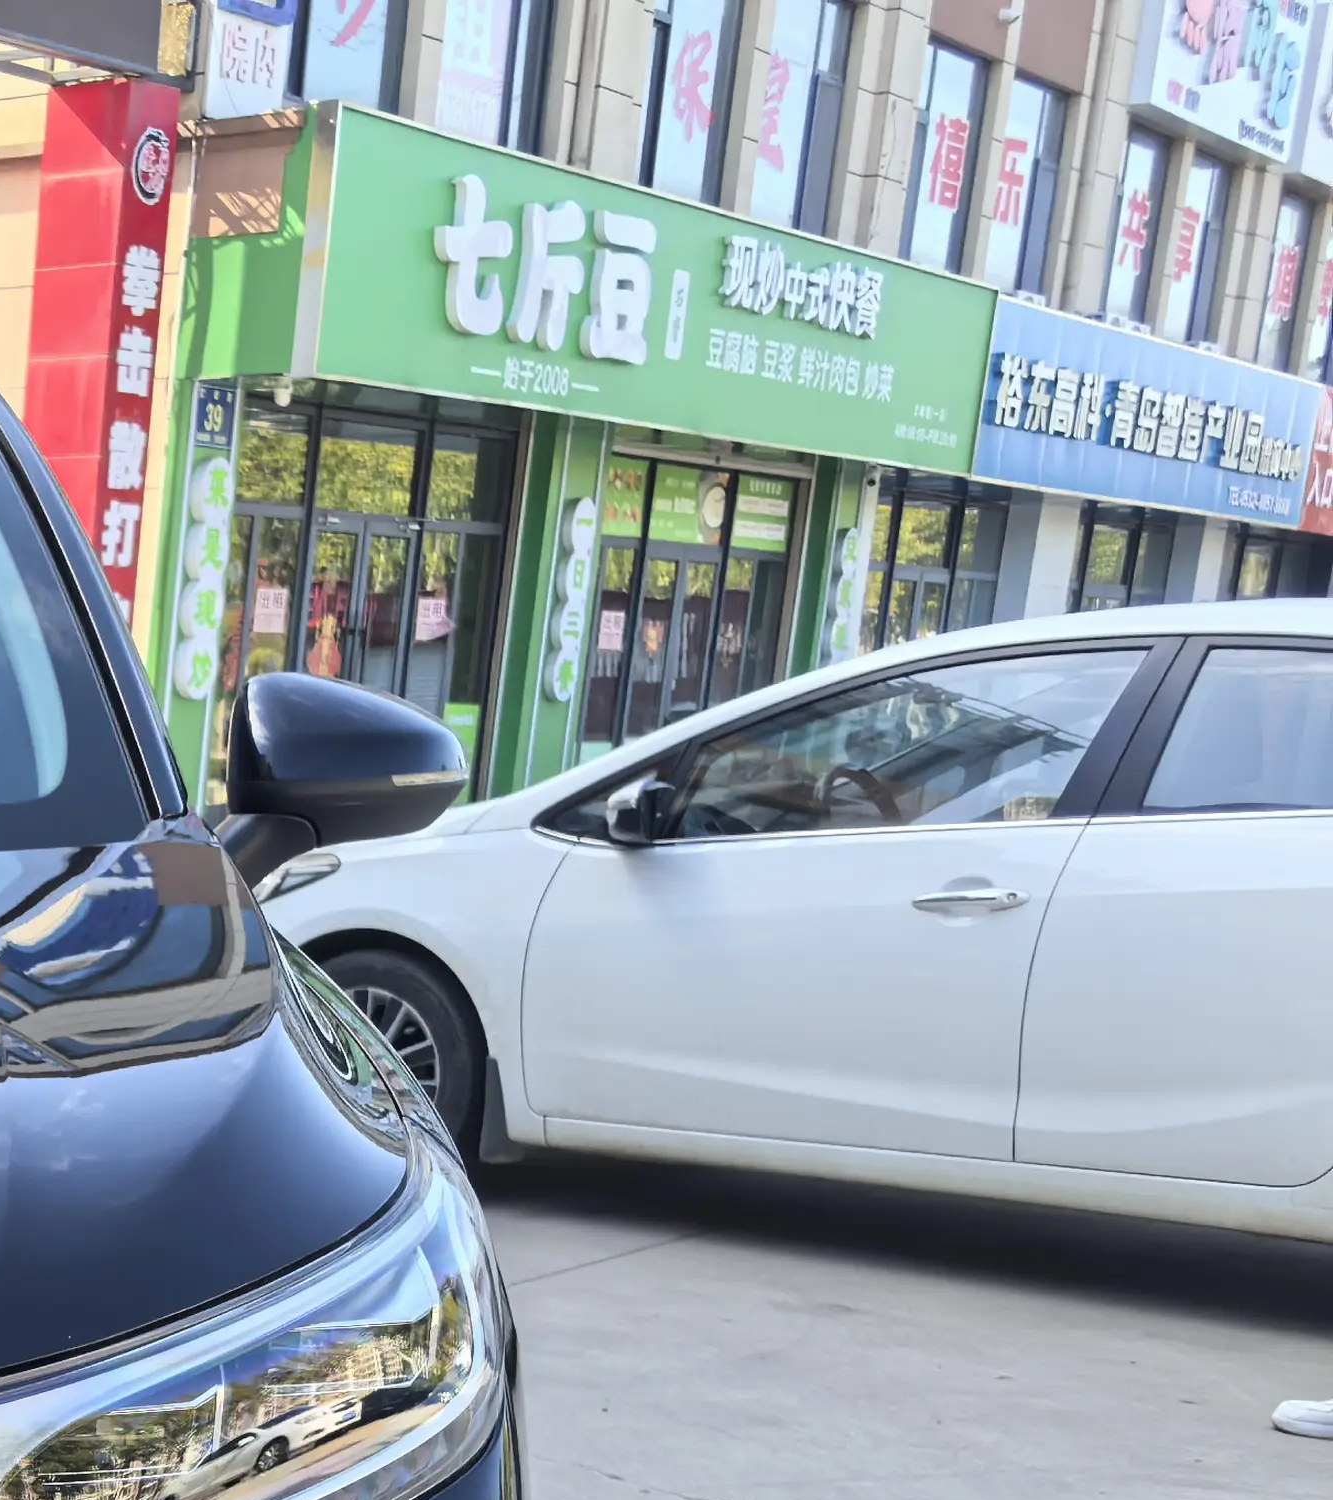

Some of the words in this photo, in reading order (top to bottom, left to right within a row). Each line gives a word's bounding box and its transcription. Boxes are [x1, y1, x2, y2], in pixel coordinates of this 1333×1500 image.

[719, 235, 883, 340] 现炒中式快餐
[761, 340, 796, 382] 豆浆
[797, 346, 860, 396] 鲜汁肉包
[862, 360, 895, 403] 炒菜
[204, 403, 225, 432] 39
